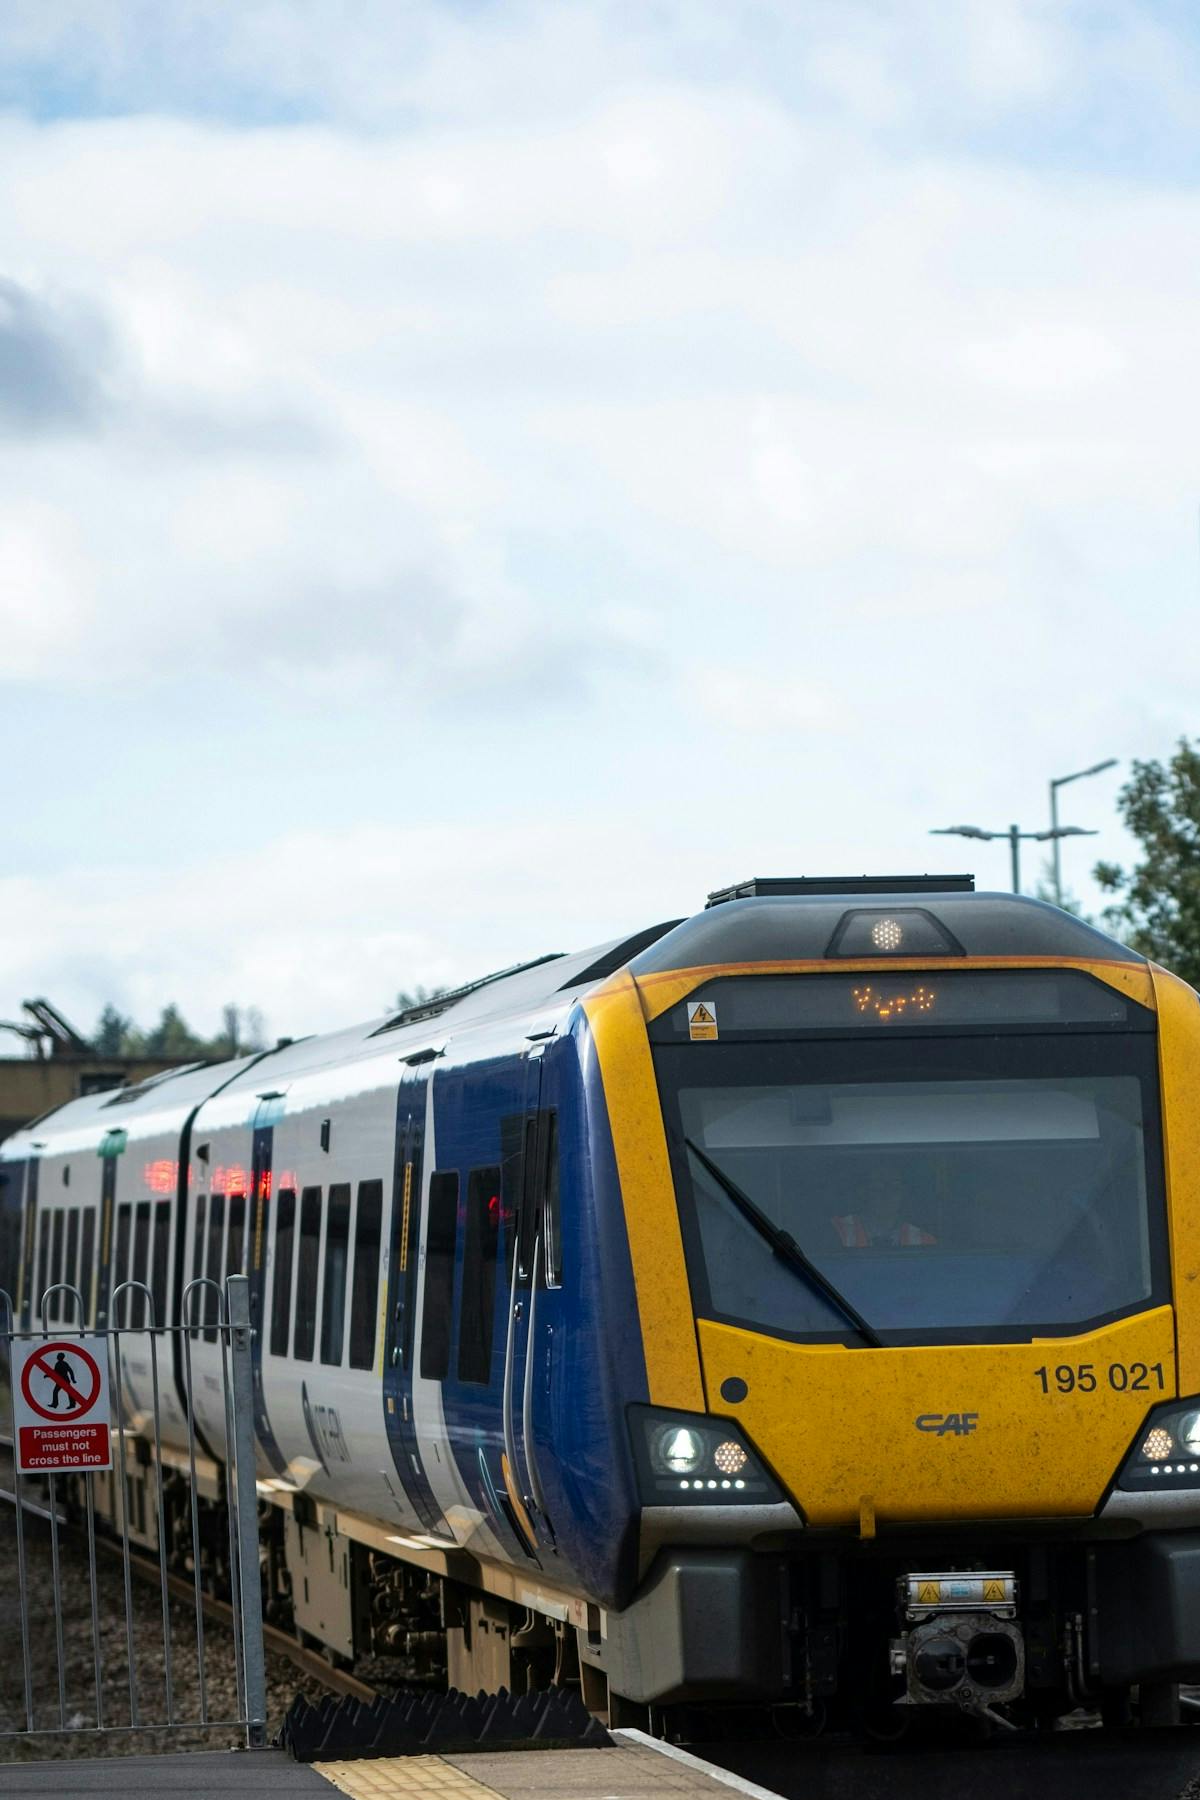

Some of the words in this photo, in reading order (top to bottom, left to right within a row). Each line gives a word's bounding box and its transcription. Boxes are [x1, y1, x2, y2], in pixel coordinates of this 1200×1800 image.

[1034, 1364, 1097, 1394] 195
[1108, 1362, 1165, 1392] 021
[915, 1413, 979, 1437] CAF
[33, 1428, 97, 1440] Passengers
[42, 1442, 69, 1452] must
[72, 1441, 90, 1450] not
[29, 1456, 60, 1465] cross
[62, 1454, 80, 1464] the
[82, 1453, 101, 1463] line
